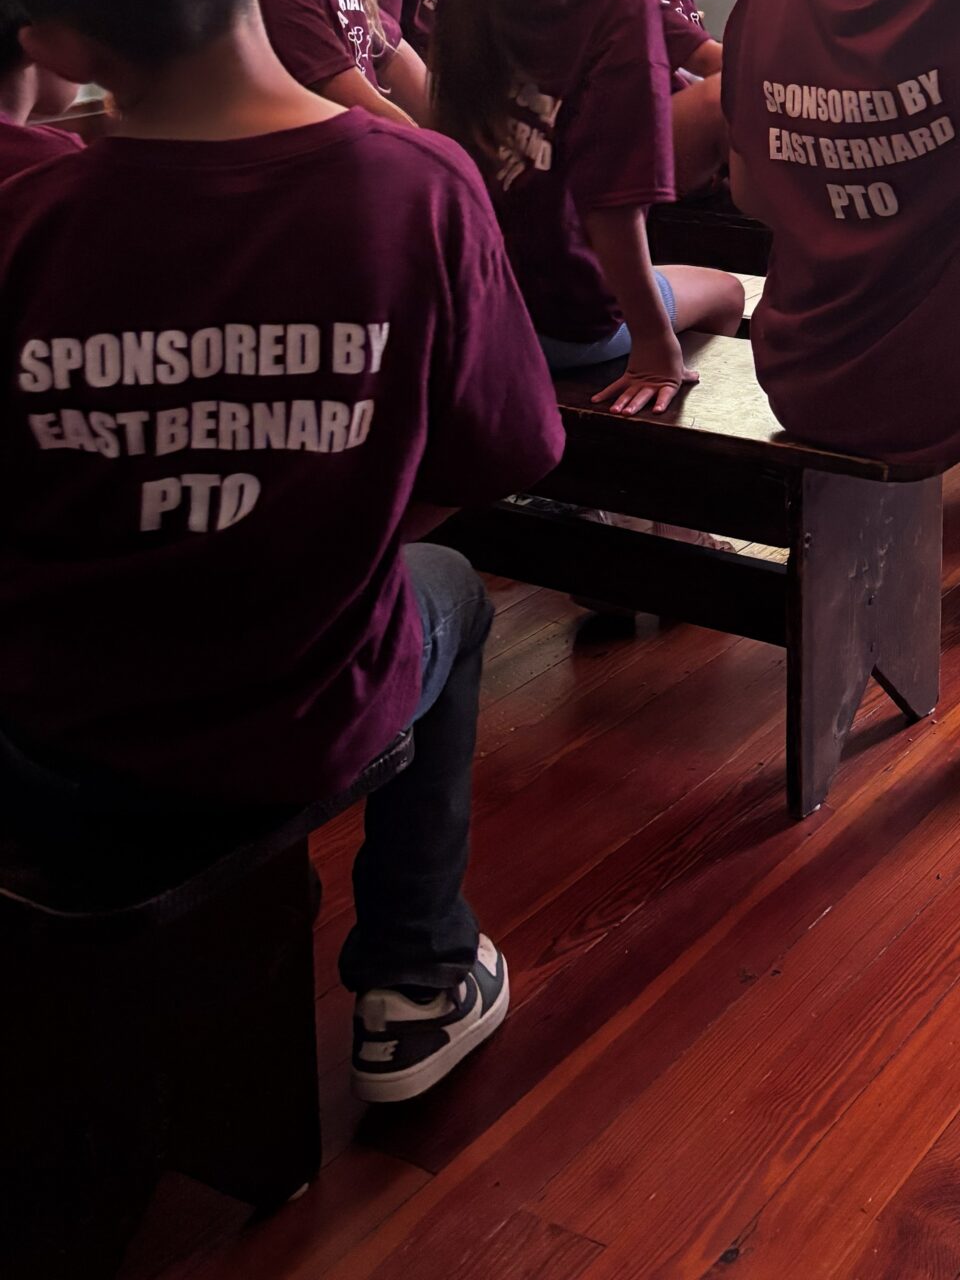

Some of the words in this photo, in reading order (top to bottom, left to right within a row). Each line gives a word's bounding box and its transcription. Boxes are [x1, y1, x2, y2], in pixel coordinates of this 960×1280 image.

[763, 80, 898, 124] SPONSORED
[897, 69, 943, 116] BY
[769, 127, 818, 167] EAST
[818, 116, 956, 170] BERNARD
[826, 182, 899, 220] PTO
[18, 323, 320, 392] SPONSORED
[332, 322, 390, 374] BY
[27, 408, 149, 459] EAST
[154, 399, 375, 456] BERNARD
[140, 473, 261, 533] PTO
